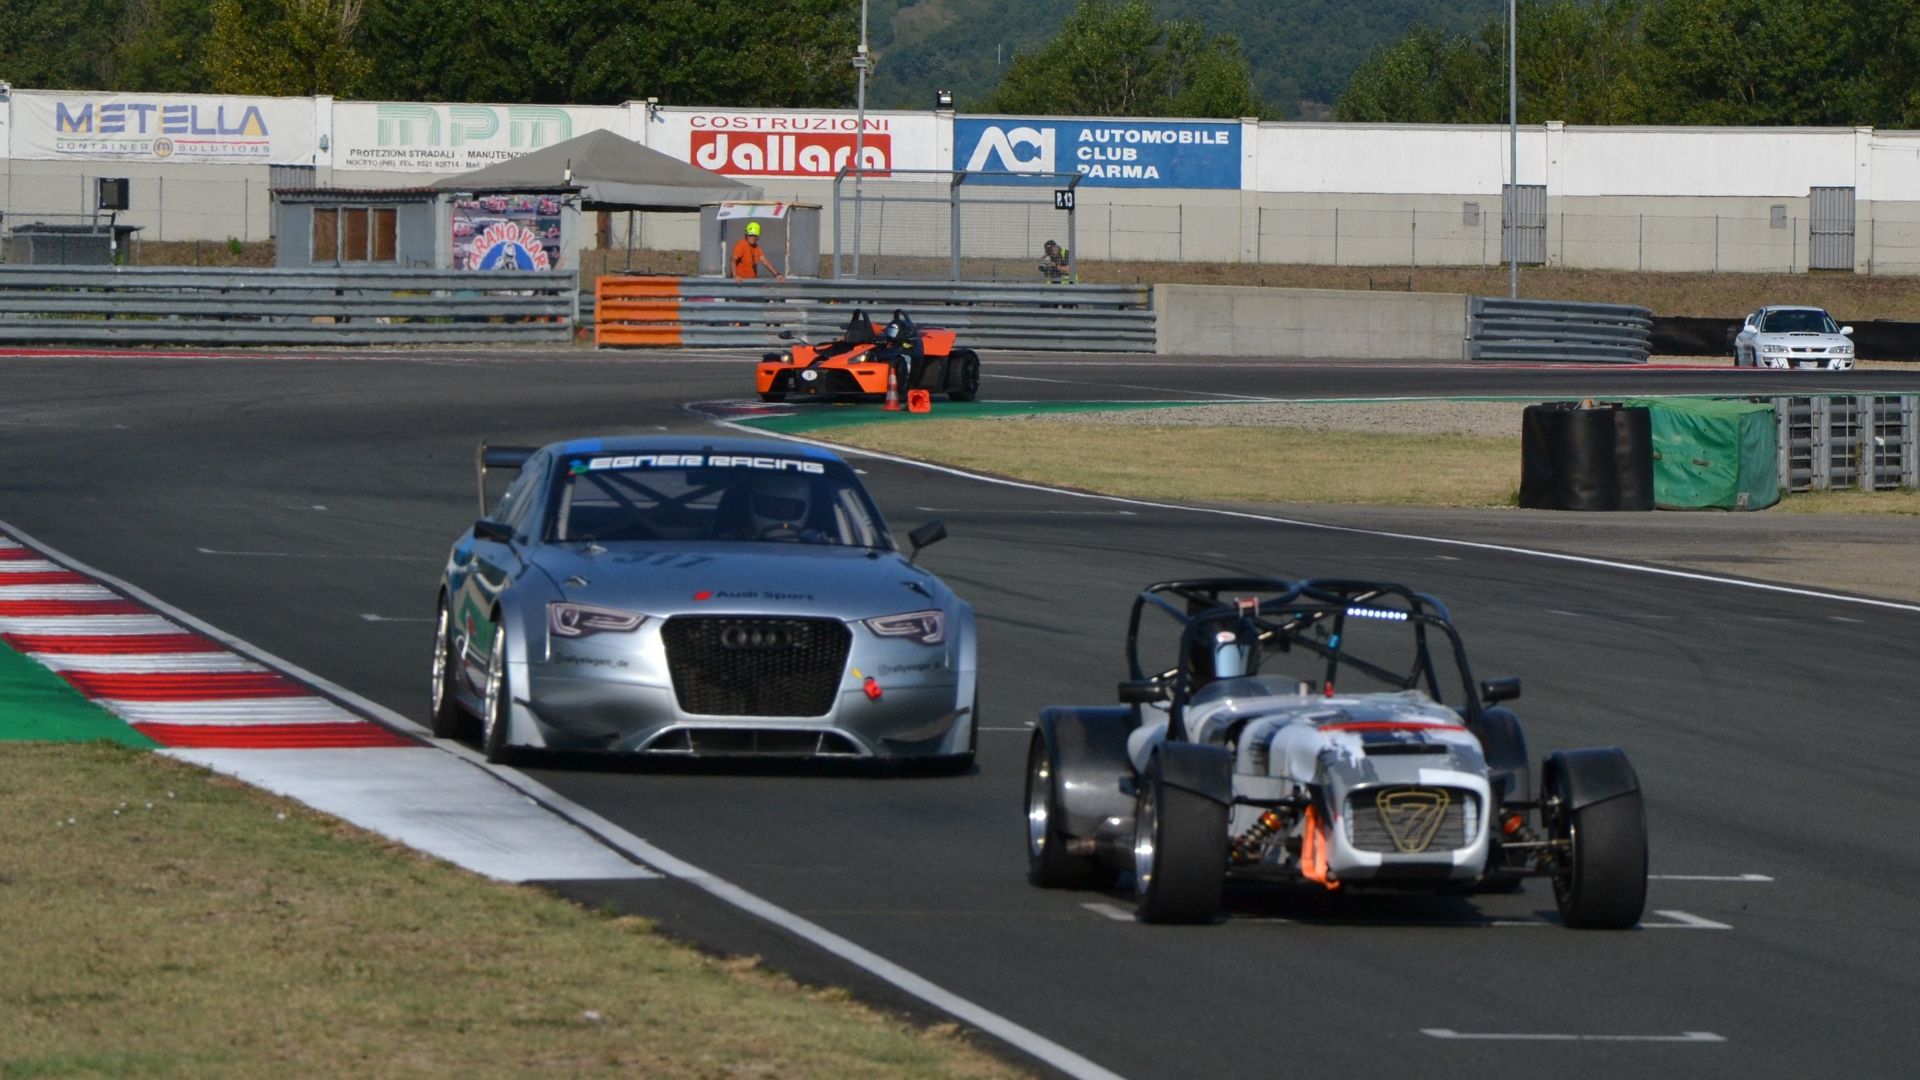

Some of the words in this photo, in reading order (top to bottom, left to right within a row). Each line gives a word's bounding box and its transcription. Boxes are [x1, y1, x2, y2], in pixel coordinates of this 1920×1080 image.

[56, 102, 269, 136] METELLA
[690, 116, 889, 131] COSTRUZIONI
[1078, 129, 1229, 145] AUTOMOBILE
[56, 143, 149, 151] CONTAINER
[178, 144, 270, 153] SOLUTIONS
[350, 149, 407, 158] PROTEZIONI
[408, 149, 455, 159] STRADALI
[696, 133, 886, 172] dallara
[966, 126, 1056, 177] ACI
[1077, 147, 1138, 161] CLUB
[1077, 164, 1160, 180] PARMA
[1063, 192, 1073, 207] 13
[589, 455, 703, 470] EGNER
[708, 455, 825, 474] RACING
[716, 590, 758, 599] Audi
[762, 591, 816, 602] Sport
